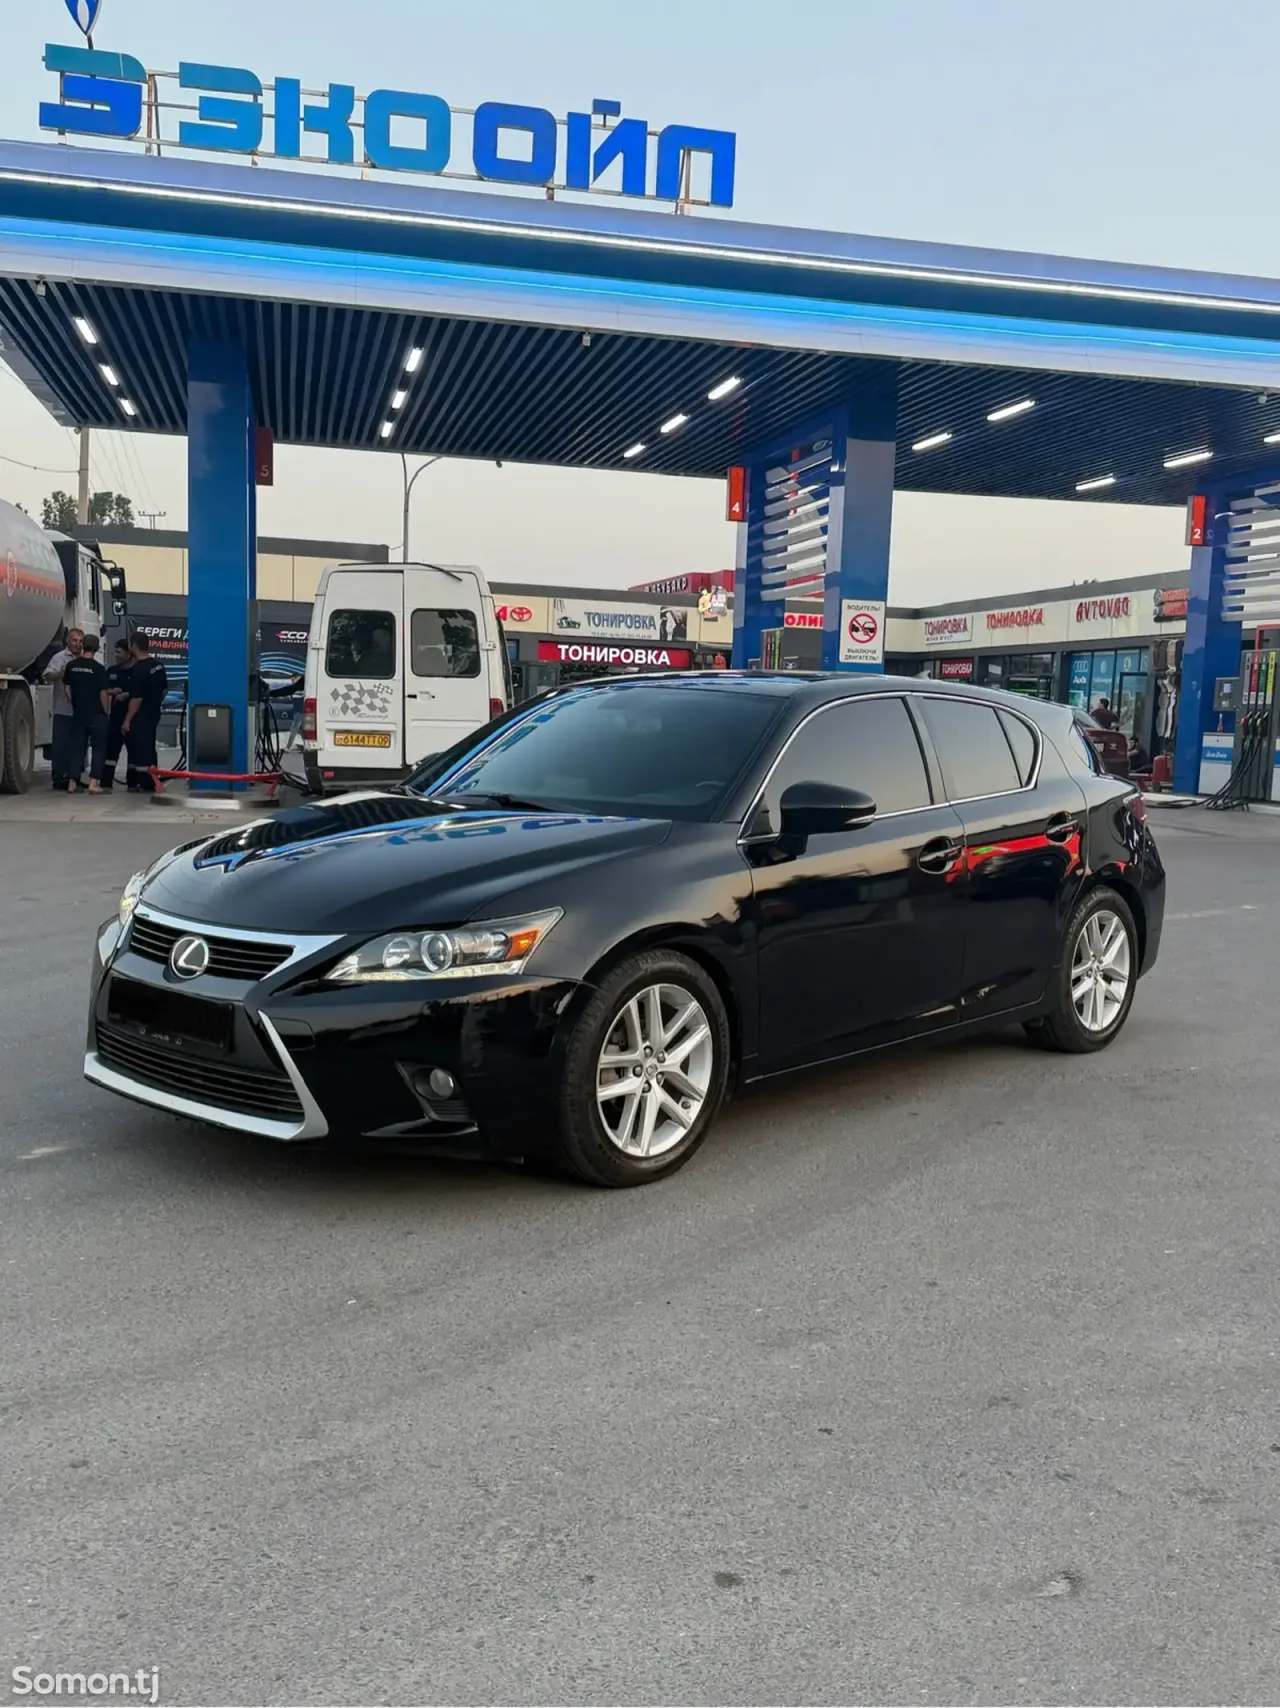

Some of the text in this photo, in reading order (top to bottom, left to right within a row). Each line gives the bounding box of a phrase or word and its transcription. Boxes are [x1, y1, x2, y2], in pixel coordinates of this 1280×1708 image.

[179, 61, 452, 175] ЭКО
[472, 97, 737, 208] ОЙЛ
[260, 464, 269, 477] 5
[732, 502, 740, 513] 4
[1193, 529, 1202, 540] 2
[584, 611, 657, 631] ТОНИРОВКА
[924, 617, 968, 636] ТОНИРОВКА
[986, 608, 1044, 630] ТОНИРОВКА
[557, 644, 671, 666] ТОНИРОВКА
[942, 663, 973, 675] ТОНИРОВКА
